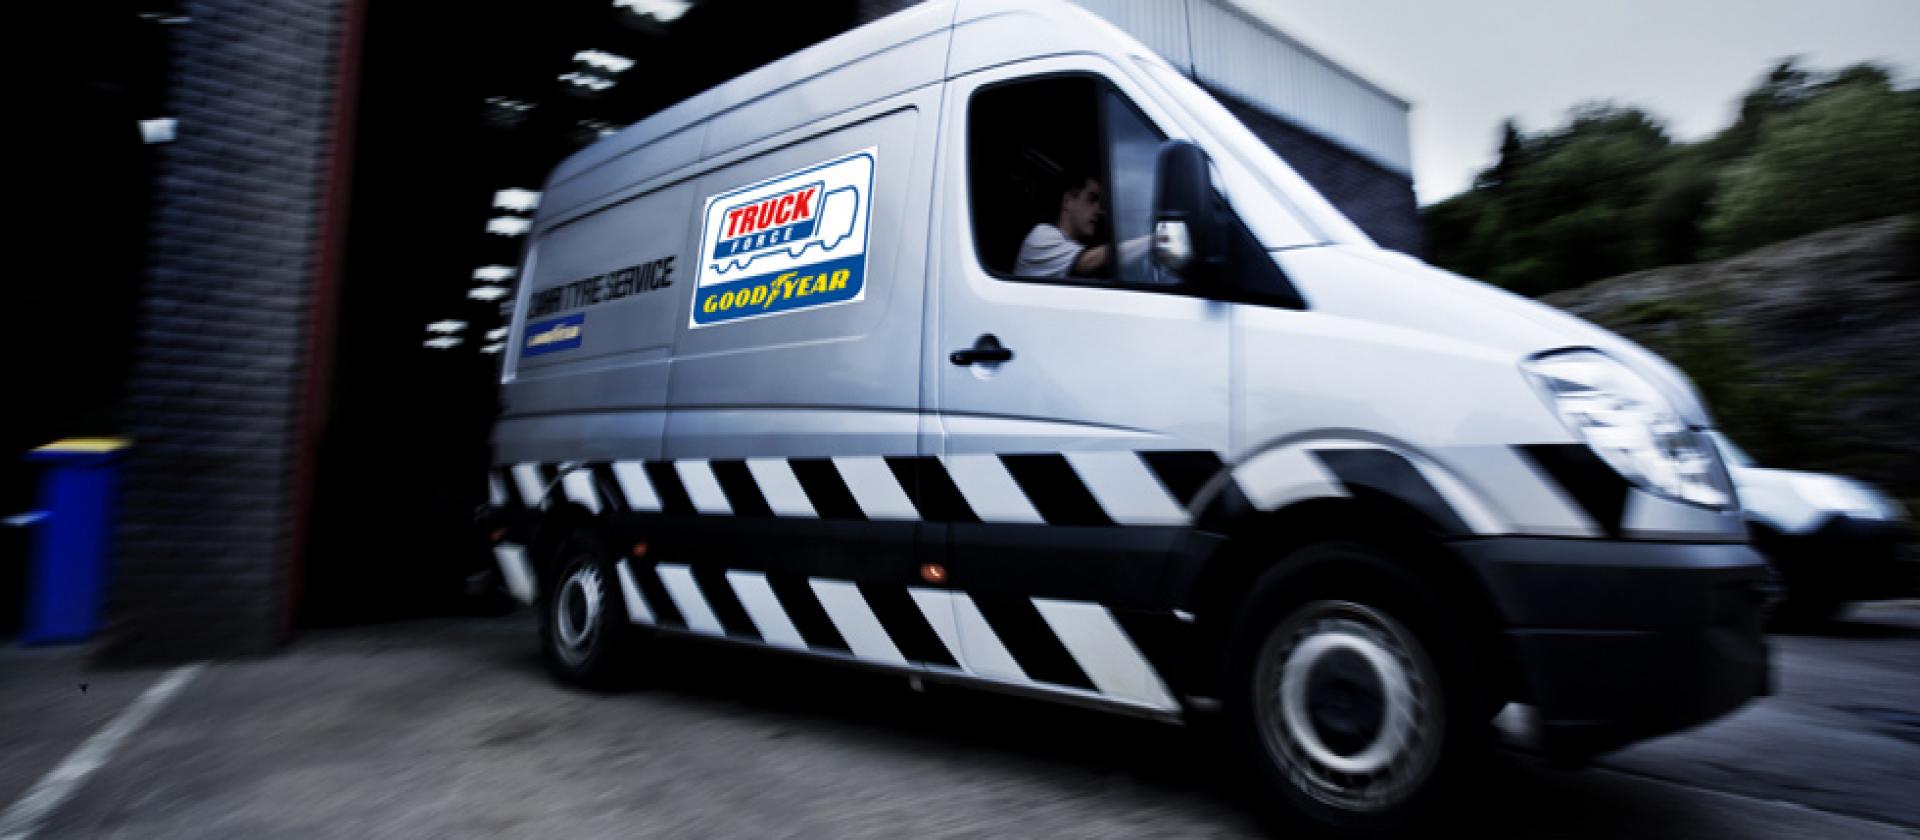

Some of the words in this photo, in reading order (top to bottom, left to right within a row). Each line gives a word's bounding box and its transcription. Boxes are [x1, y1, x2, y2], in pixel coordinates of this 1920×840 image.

[727, 188, 815, 238] TRUCK
[730, 227, 793, 254] FORCE
[603, 254, 675, 302] SERVICE
[703, 269, 850, 312] GOODYEAR
